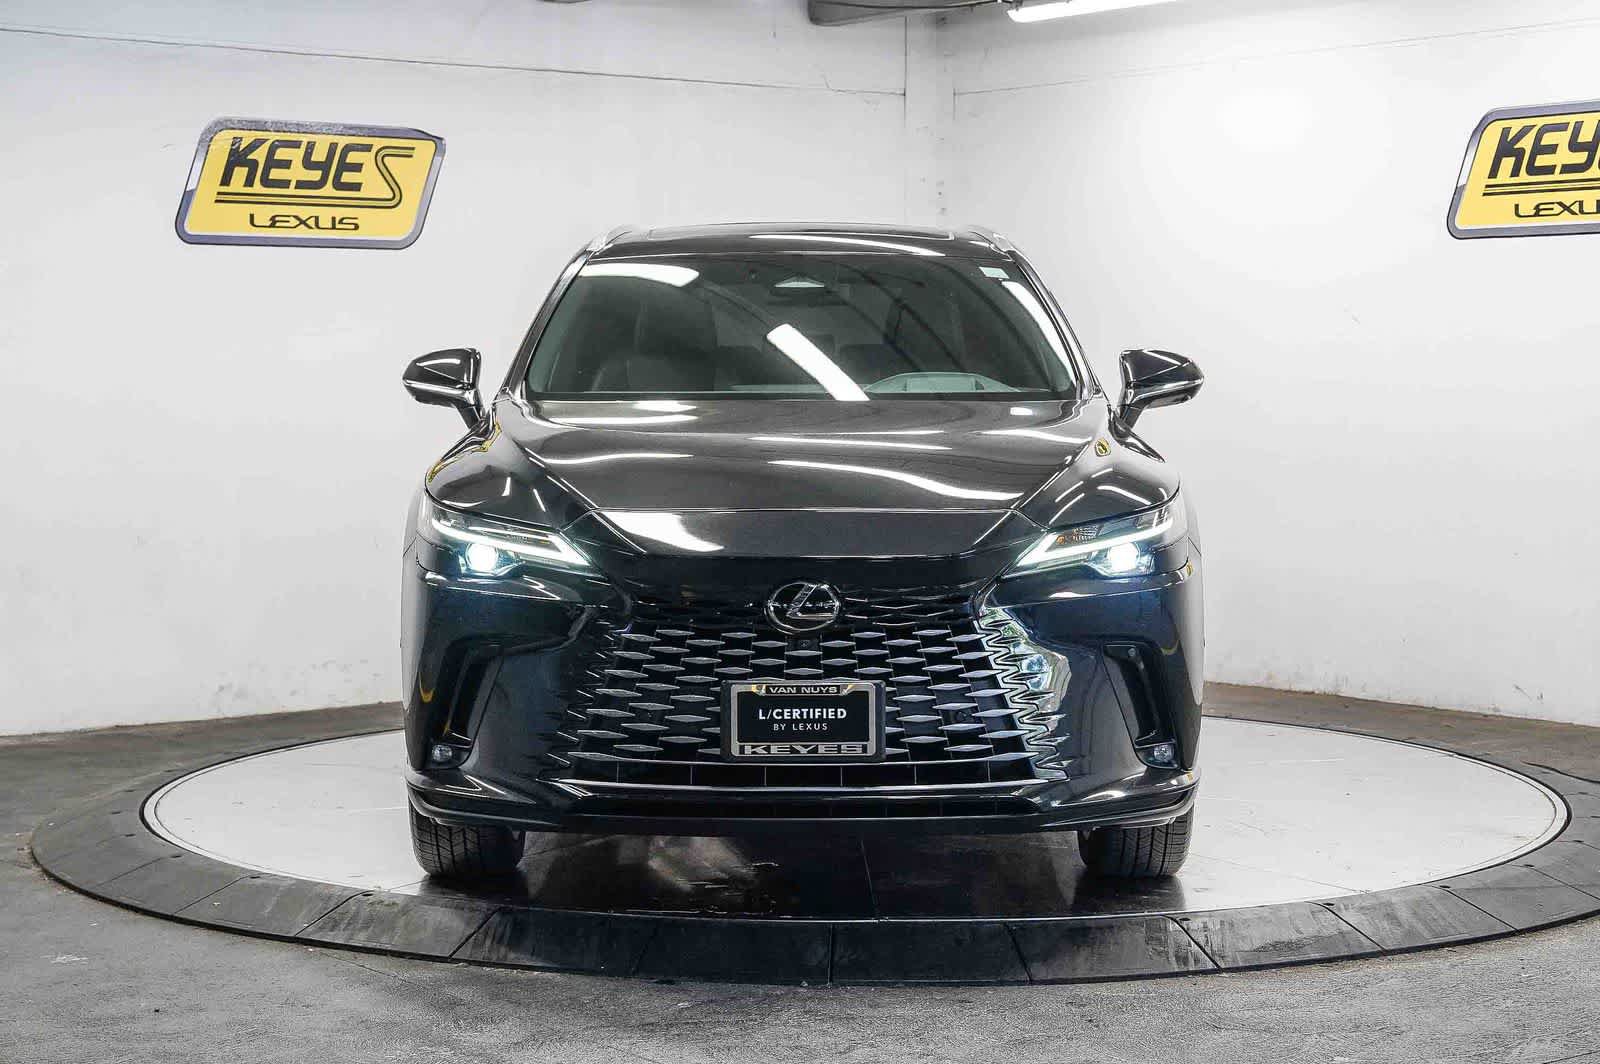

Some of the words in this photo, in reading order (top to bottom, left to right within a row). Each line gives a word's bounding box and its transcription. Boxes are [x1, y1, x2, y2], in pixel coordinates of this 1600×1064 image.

[1487, 119, 1600, 179] KEY
[216, 136, 416, 209] KEYES
[249, 213, 360, 231] LEXUS
[769, 686, 797, 694] VAN
[801, 686, 838, 694] NUYS
[758, 708, 847, 720] L/CERTIFIED
[773, 723, 787, 731] BY
[792, 722, 828, 731] LEXUS
[744, 744, 863, 755] KEYES
